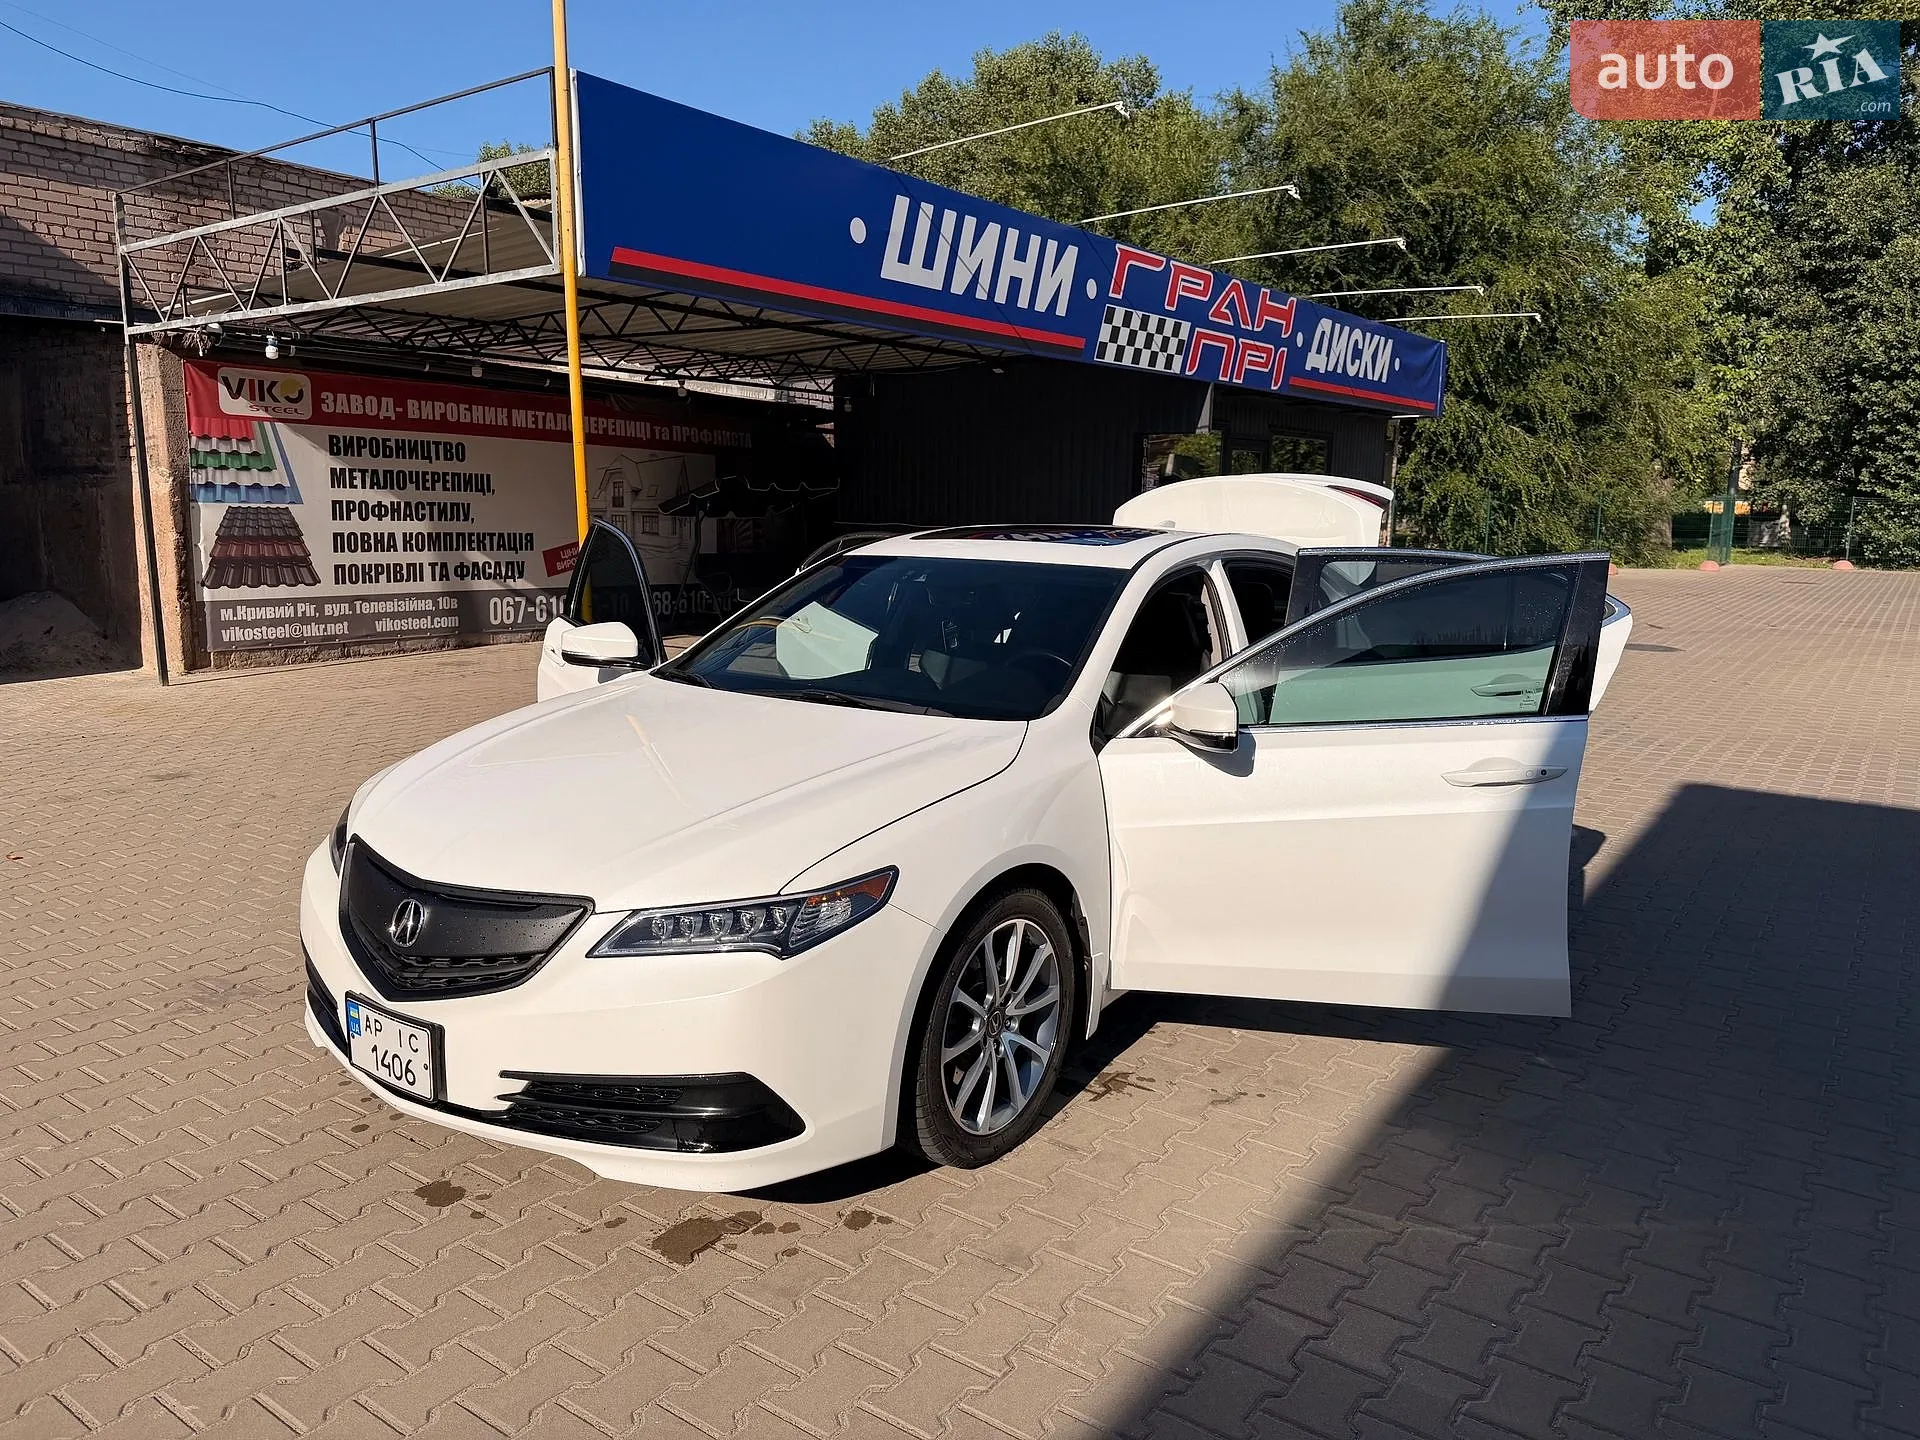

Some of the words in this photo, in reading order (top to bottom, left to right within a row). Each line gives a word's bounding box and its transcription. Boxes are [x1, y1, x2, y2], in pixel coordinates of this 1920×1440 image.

[881, 195, 1079, 317] ШИНИ
[1109, 243, 1296, 338] ГРАН
[1186, 328, 1289, 390] ПРІ
[1305, 317, 1394, 384] ДИСКИ
[221, 376, 305, 404] VIKO
[249, 404, 305, 416] STEEL
[407, 399, 509, 427] ВИРОБНИК
[653, 425, 670, 441] та
[328, 434, 466, 464] ВИРОБНИЦТВО
[330, 467, 496, 496] МЕТАЛОЧЕРЕПИЦІ,
[331, 499, 475, 525] ПРОФНАСТИЛУ,
[332, 532, 398, 553] ПОВНА
[402, 532, 535, 554] КОМПЛЕКТАЦІЯ
[333, 562, 424, 585] ПОКРІВЛІ
[428, 562, 450, 581] ТА
[453, 561, 526, 583] ФАСАДУ
[556, 556, 578, 571] ВИРО
[297, 604, 320, 618] Ріг,
[324, 604, 352, 617] вул.
[354, 597, 436, 613] Телевізійна,
[221, 622, 350, 642] vikosteel@ukr.net
[375, 615, 460, 632] vikosteel.com
[350, 1021, 361, 1035] UA
[365, 1014, 383, 1037] AP
[371, 1044, 417, 1087] 1406
